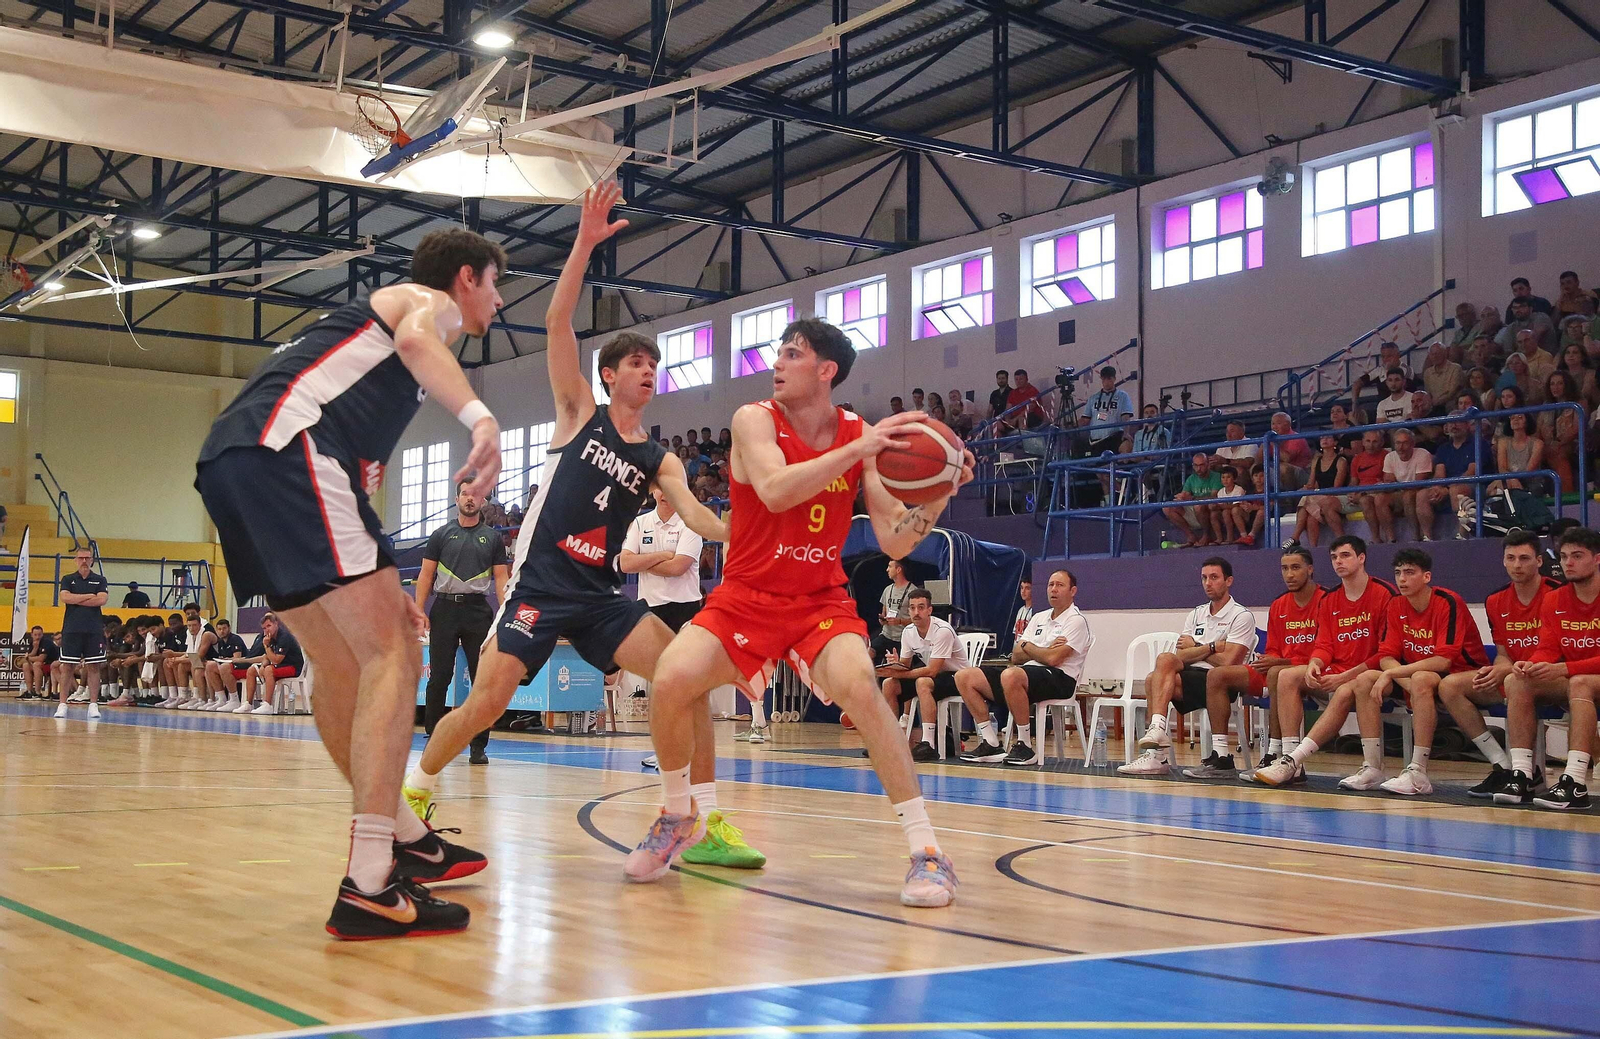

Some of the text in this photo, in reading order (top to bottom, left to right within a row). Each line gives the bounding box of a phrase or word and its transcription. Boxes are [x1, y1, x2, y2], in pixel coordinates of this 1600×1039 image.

[580, 439, 646, 495] FRANCE
[593, 485, 611, 512] 4
[808, 504, 826, 533] 9
[566, 534, 607, 560] MAIF
[1286, 619, 1316, 630] ESPAÑA
[1561, 618, 1600, 631] ESPAÑ
[1338, 628, 1370, 642] endes
[1561, 636, 1600, 648] endes
